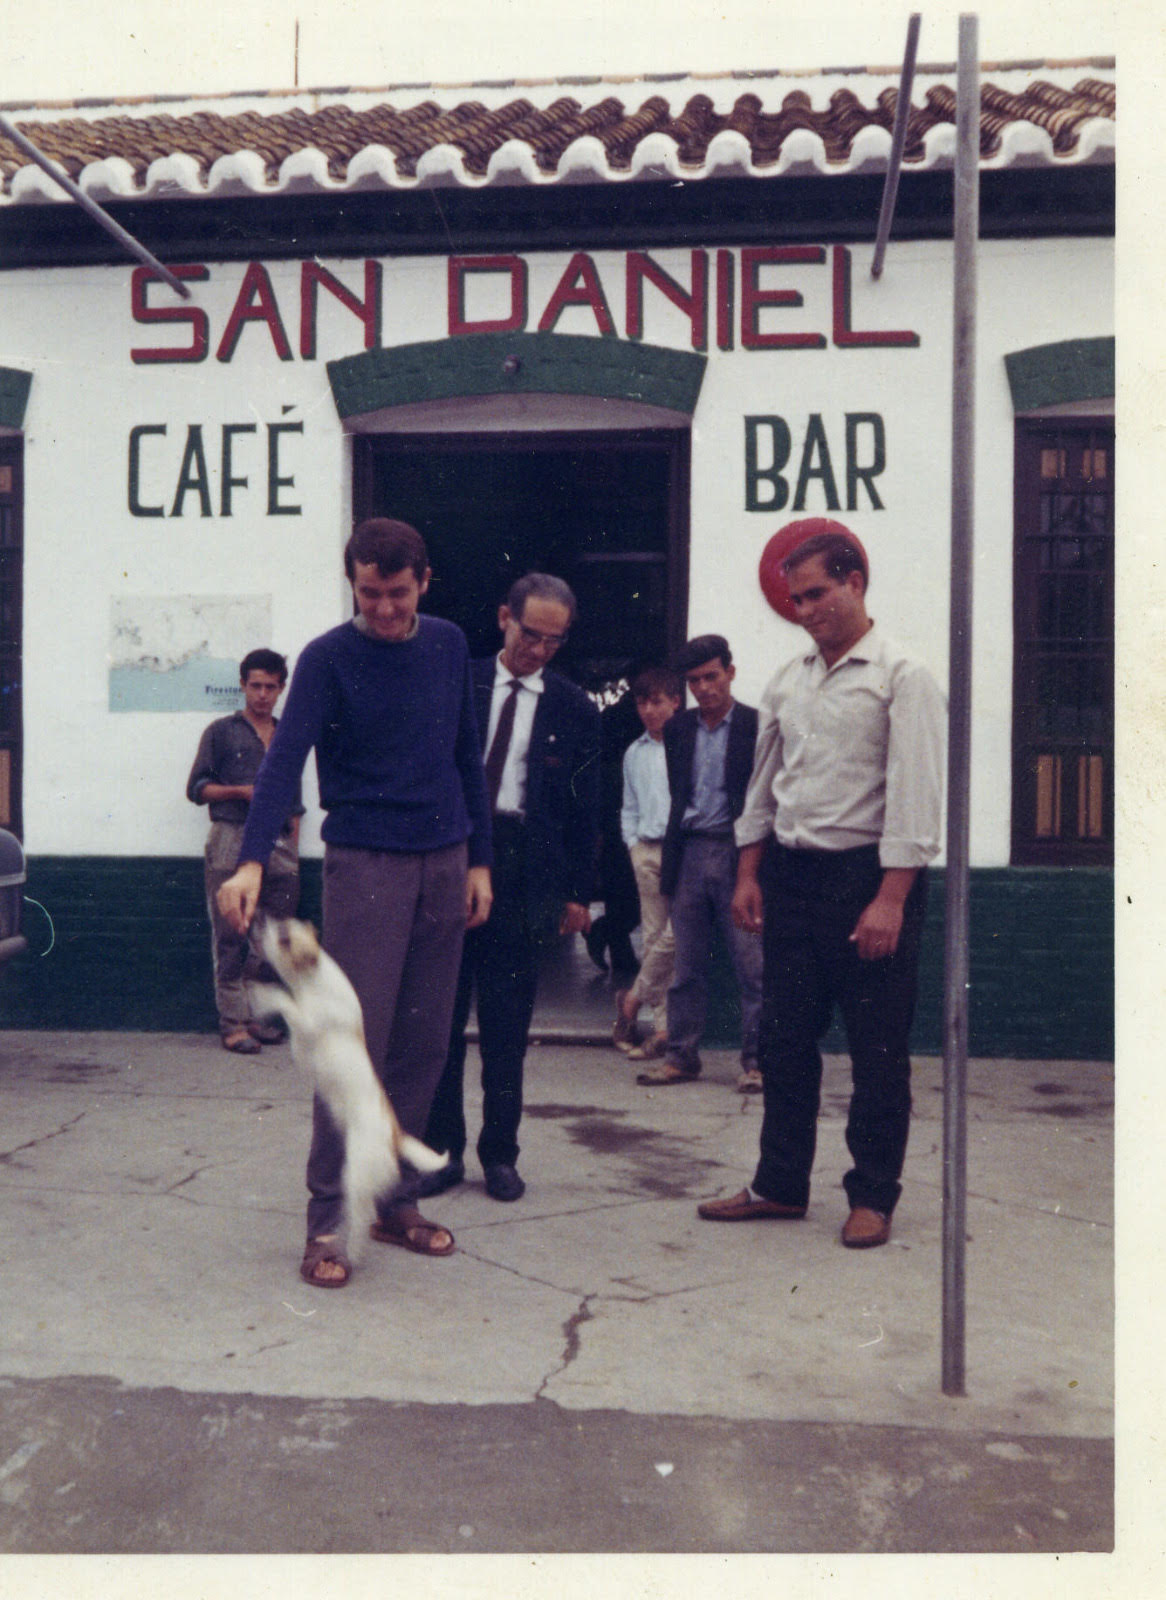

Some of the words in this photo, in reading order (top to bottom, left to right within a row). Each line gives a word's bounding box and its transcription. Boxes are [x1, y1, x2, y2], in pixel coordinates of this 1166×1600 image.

[131, 259, 382, 364] SAN
[448, 246, 920, 351] DANIEL
[128, 405, 304, 518] CAFÉ
[744, 413, 887, 513] BAR
